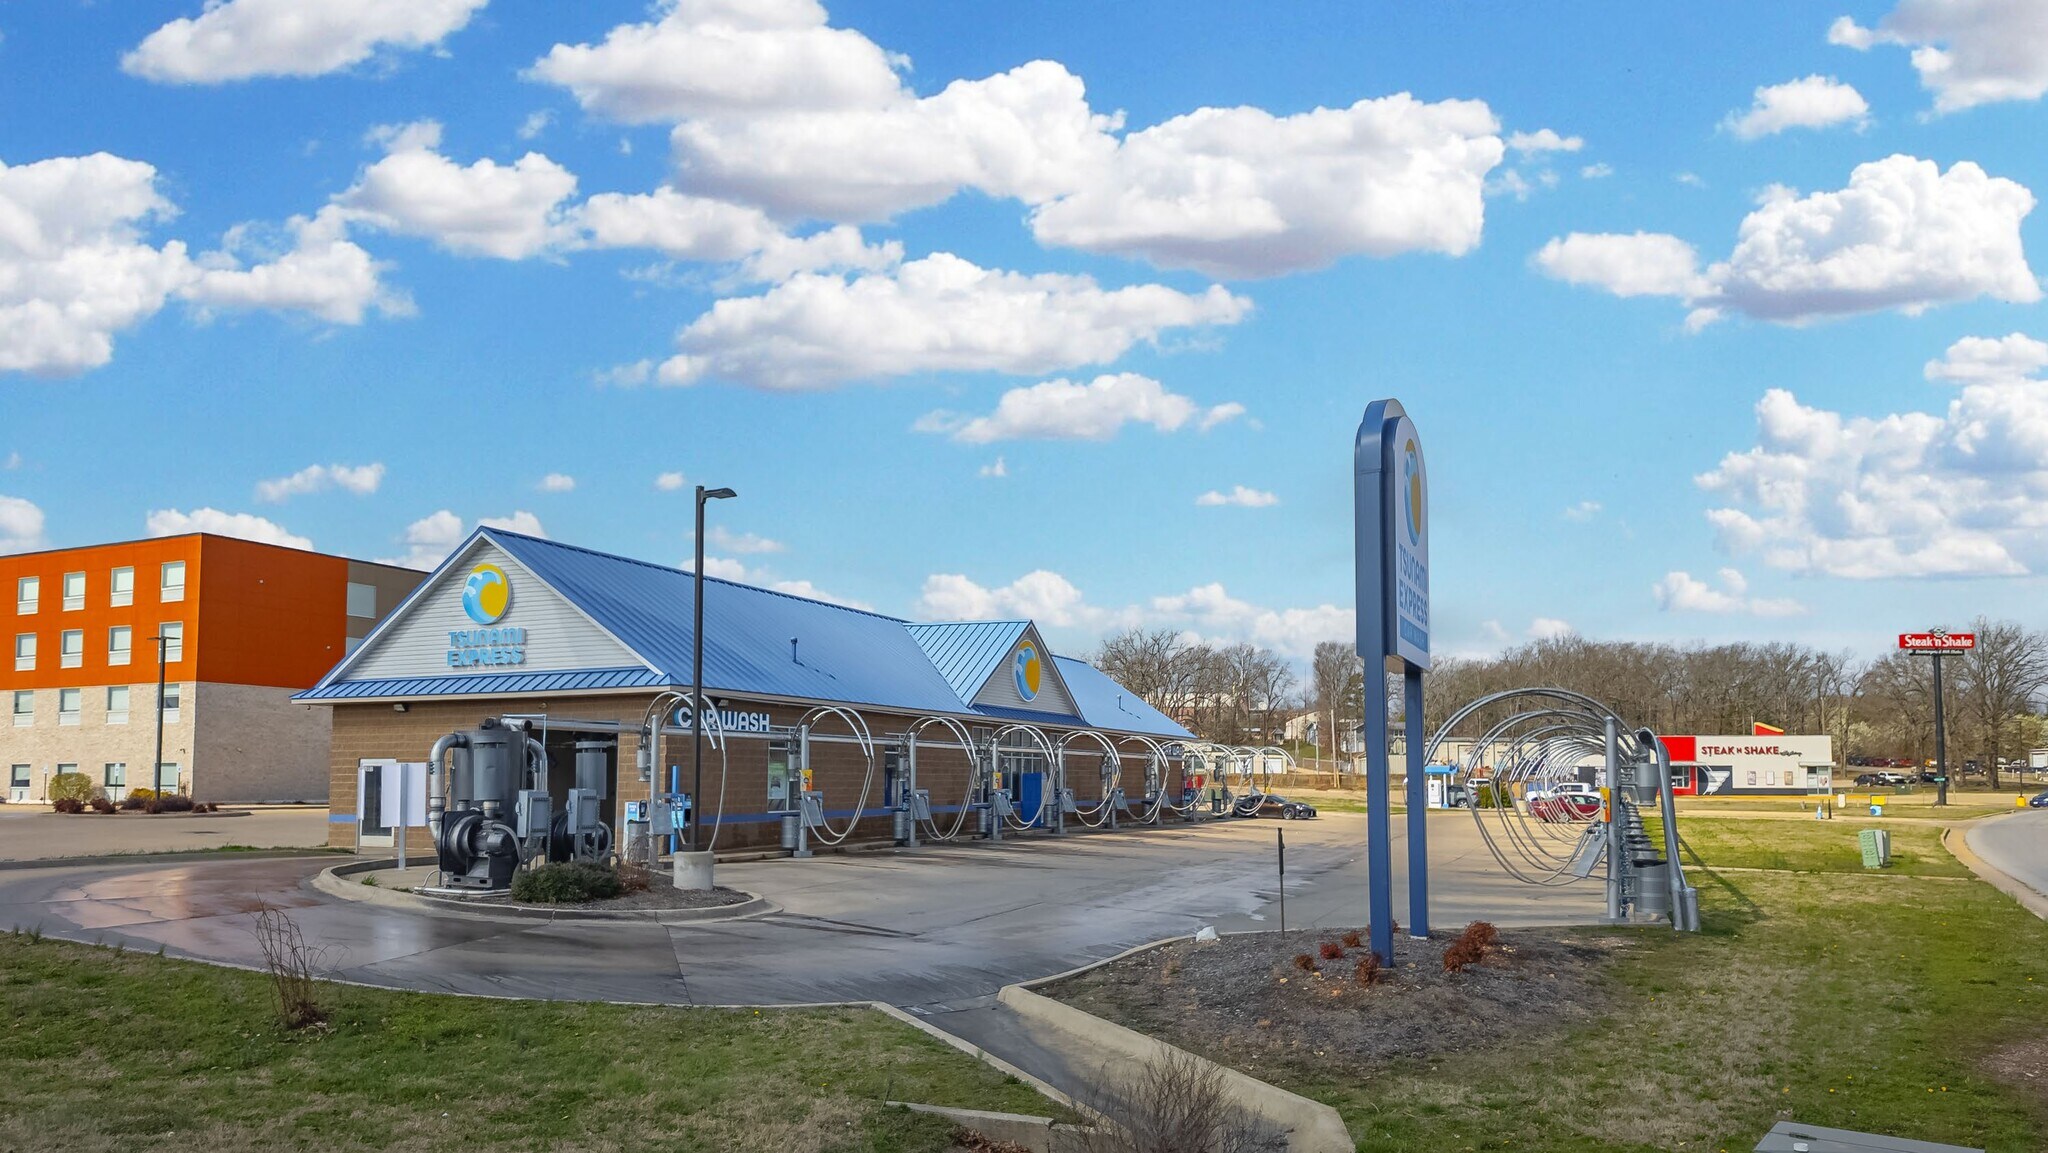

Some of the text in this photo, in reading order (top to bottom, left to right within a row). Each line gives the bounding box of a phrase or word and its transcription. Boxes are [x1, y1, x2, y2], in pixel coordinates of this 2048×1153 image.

[1399, 578, 1428, 626] EXPRESS
[448, 627, 527, 648] TSUNAMI
[1904, 634, 1933, 647] Steak
[1942, 635, 1973, 647] Shake
[447, 647, 525, 667] EXPRESS
[721, 710, 770, 732] WASH
[1701, 746, 1735, 757] STEAK
[1744, 746, 1779, 755] SHAKE
